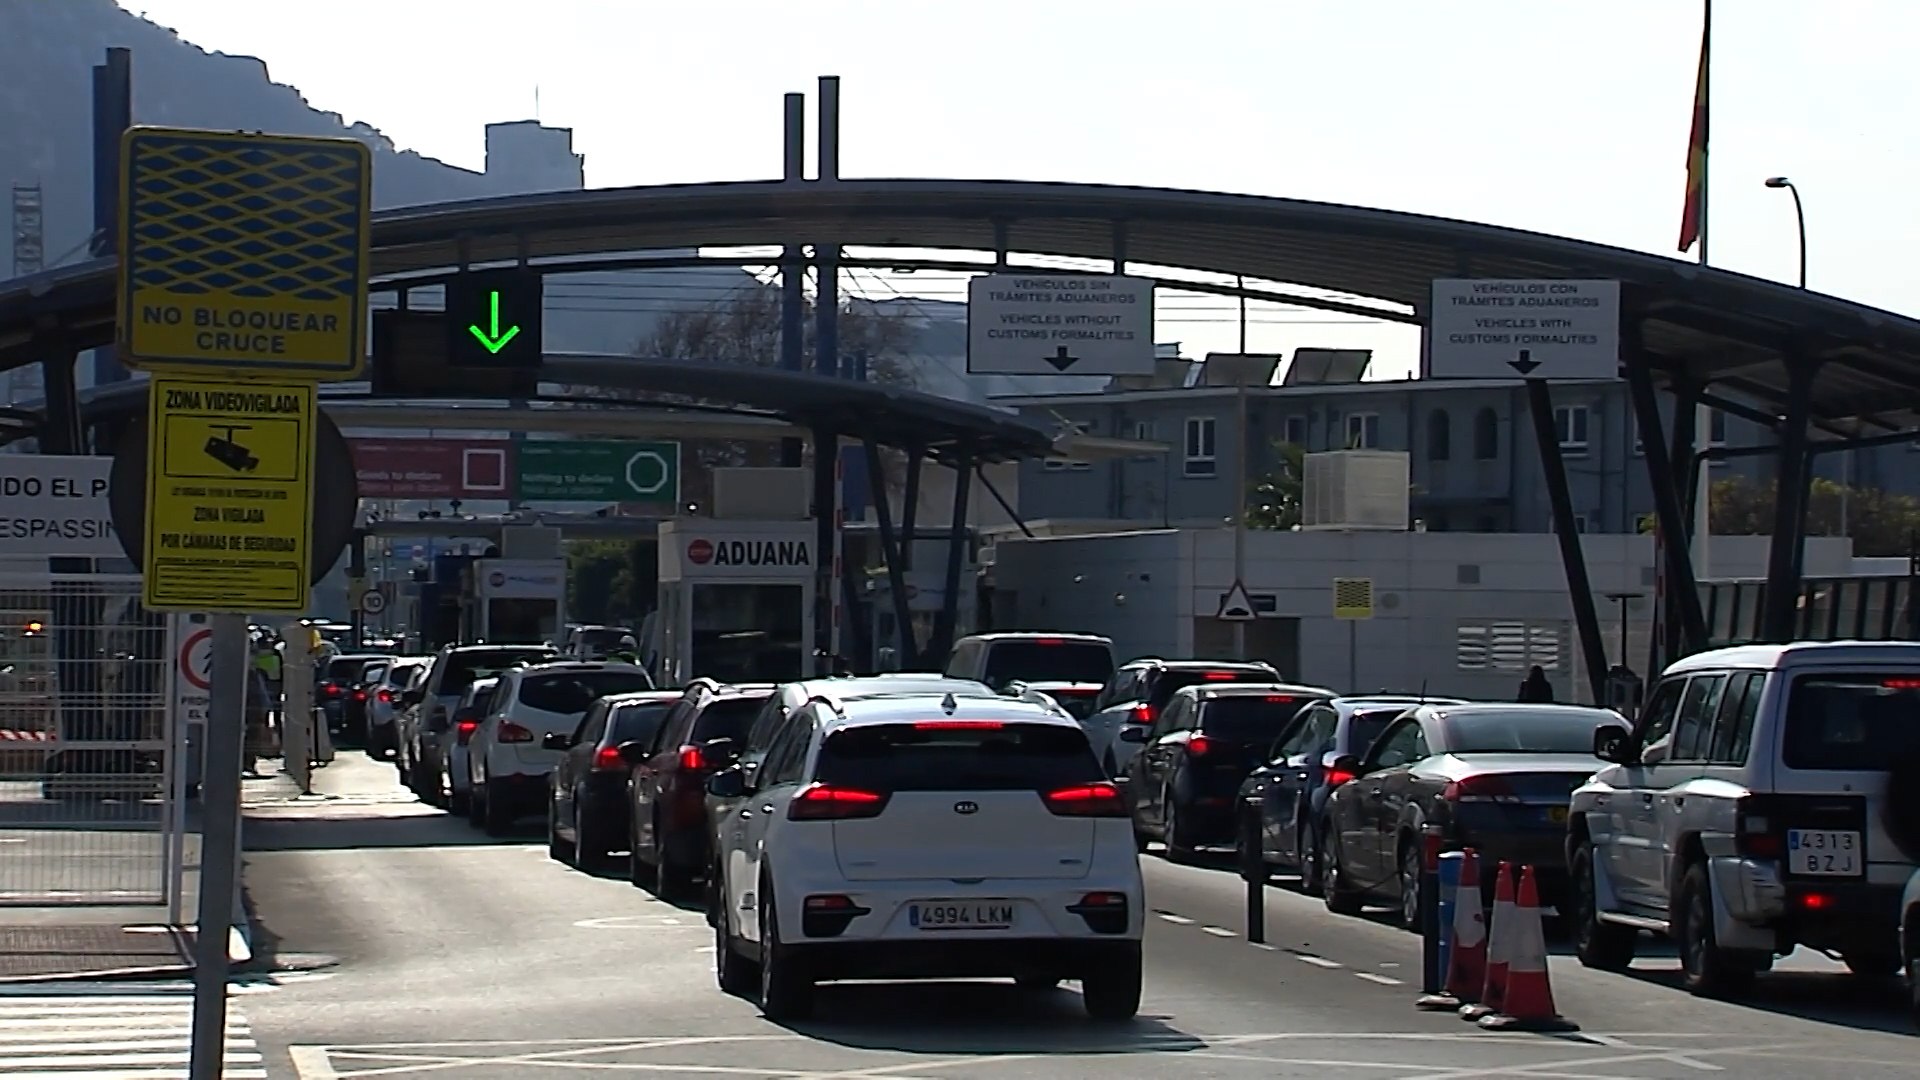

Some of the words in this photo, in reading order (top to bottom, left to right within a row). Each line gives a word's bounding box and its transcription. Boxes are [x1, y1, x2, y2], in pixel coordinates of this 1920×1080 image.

[1090, 280, 1111, 290] SIN
[1549, 284, 1578, 294] CON
[1055, 293, 1136, 304] ADUANEROS
[1518, 297, 1600, 308] ADUANEROS
[143, 306, 182, 325] NO
[194, 309, 338, 332] BLOQUEAR
[1000, 314, 1061, 325] VEHICLES
[1065, 315, 1122, 325] WITHOUT
[1474, 318, 1537, 328] VEHICLES
[1540, 318, 1572, 328] WITH
[987, 329, 1048, 340] CUSTOMS
[1052, 330, 1135, 340] FORMALITIES
[1449, 333, 1511, 344] CUSTOMS
[1514, 334, 1599, 344] FORMALITIES
[196, 332, 285, 353] CRUCE
[166, 389, 202, 410] ZONA
[205, 391, 300, 413] VIDEOVIGILADA
[0, 478, 42, 497] DO
[51, 479, 83, 498] EL
[714, 541, 810, 566] ADUANA
[1801, 833, 1854, 850] 4313
[1807, 855, 1853, 872] BZJ
[922, 906, 969, 924] 4994
[977, 905, 1013, 923] LKM
